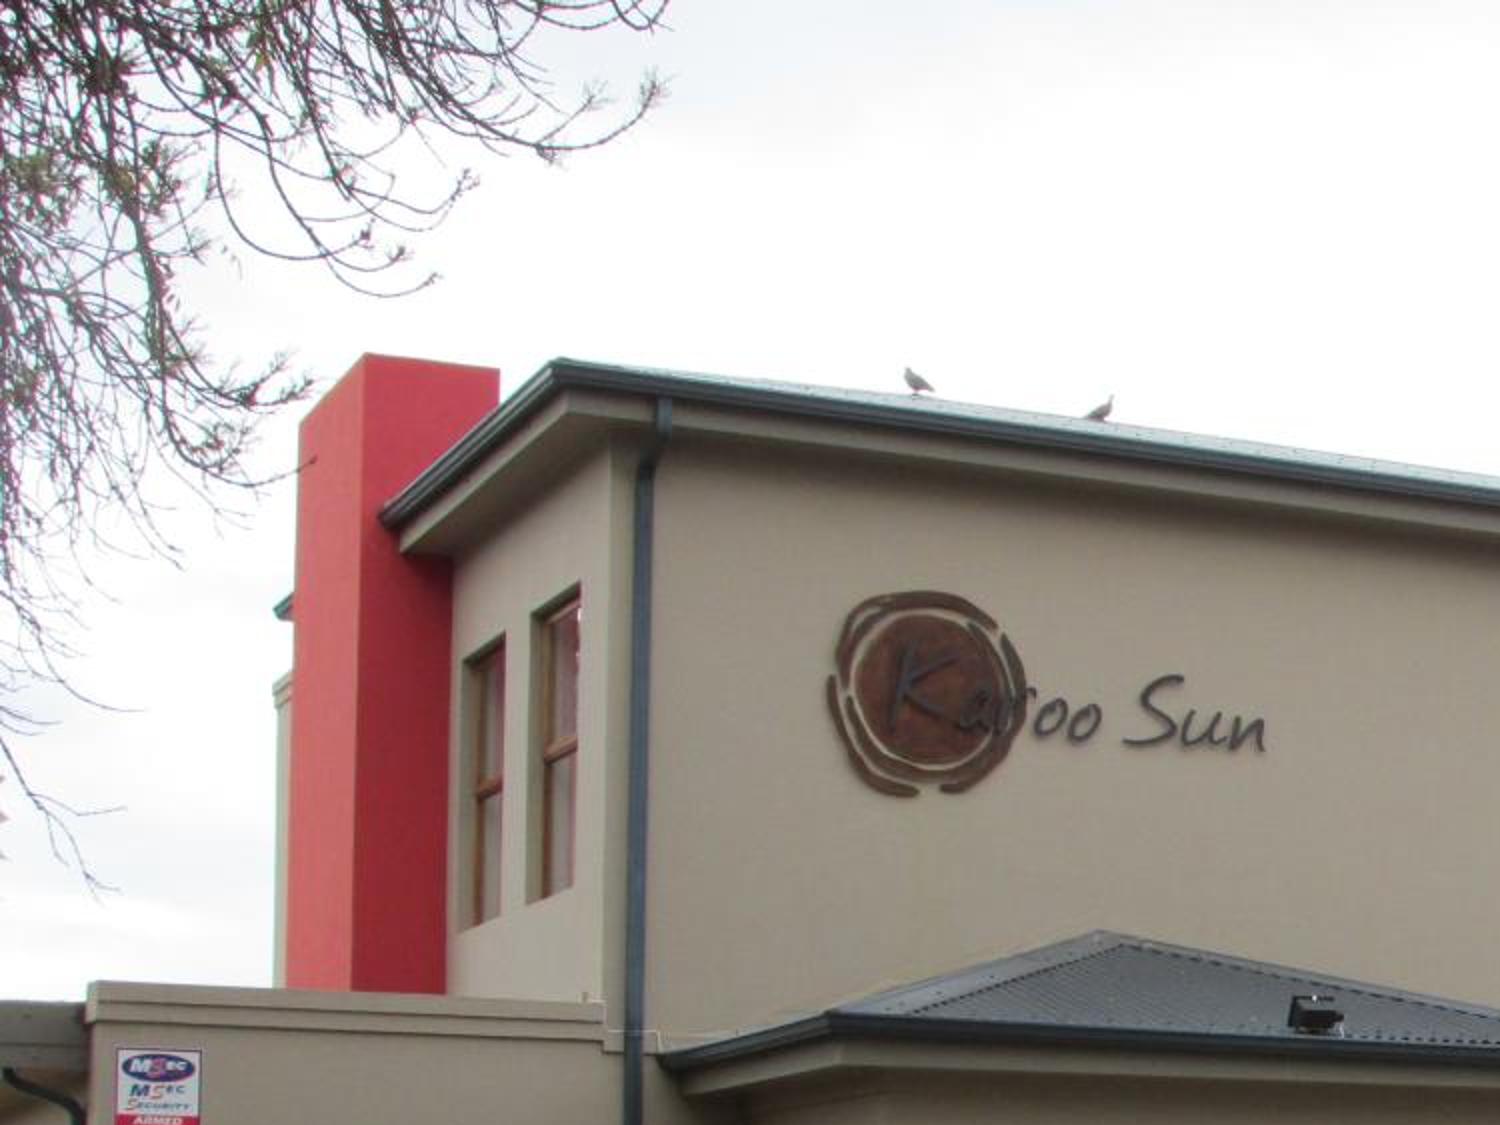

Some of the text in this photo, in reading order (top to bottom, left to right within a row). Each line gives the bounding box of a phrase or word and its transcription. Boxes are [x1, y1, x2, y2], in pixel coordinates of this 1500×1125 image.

[889, 640, 1267, 753] Karoo Sun
[133, 1115, 183, 1125] ARMED
